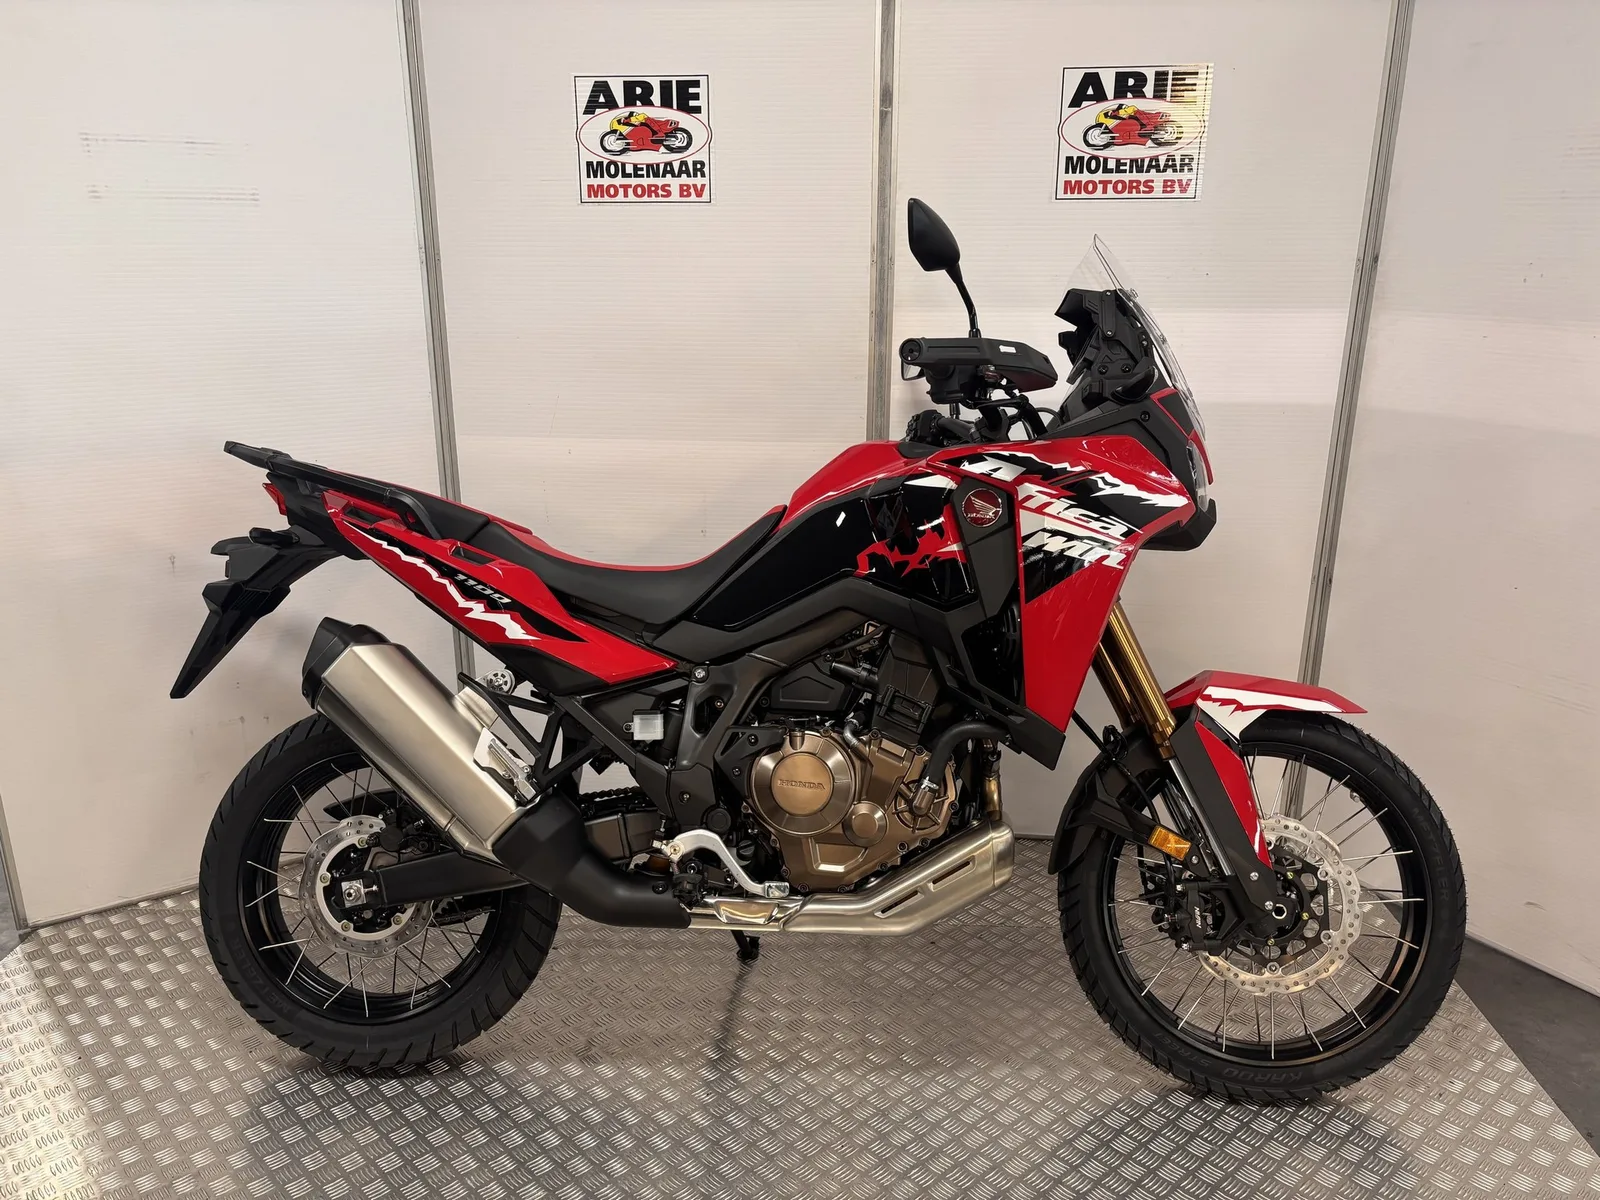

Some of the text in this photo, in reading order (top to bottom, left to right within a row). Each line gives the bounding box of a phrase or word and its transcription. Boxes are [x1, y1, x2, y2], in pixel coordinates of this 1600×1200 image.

[582, 80, 702, 115] ARIE
[1067, 70, 1199, 108] ARIE
[586, 160, 706, 179] MOLENAAR
[1064, 154, 1194, 174] MOLENAAR
[587, 184, 706, 199] MOTORS BV
[1063, 178, 1193, 195] MOTORS BV
[454, 573, 512, 604] 1100
[777, 778, 826, 791] HONDA
